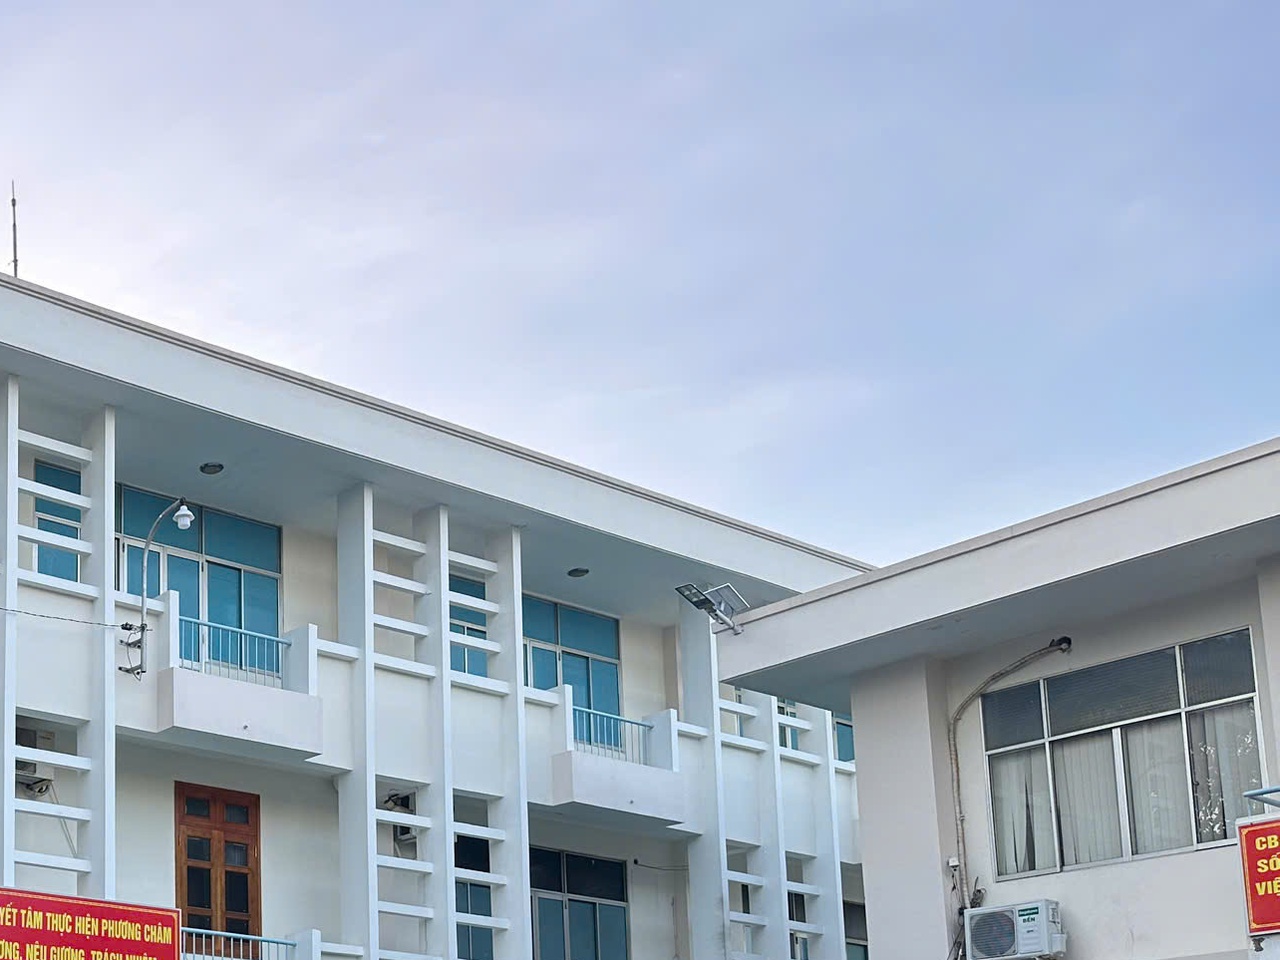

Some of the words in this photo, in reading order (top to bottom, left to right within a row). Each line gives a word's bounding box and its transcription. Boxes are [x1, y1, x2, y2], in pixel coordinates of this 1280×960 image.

[20, 906, 43, 930] TÂM
[46, 912, 72, 936] THỰC
[74, 913, 99, 939] HIỆN
[101, 919, 141, 941] PHƯƠNG
[143, 922, 172, 945] CHÂM
